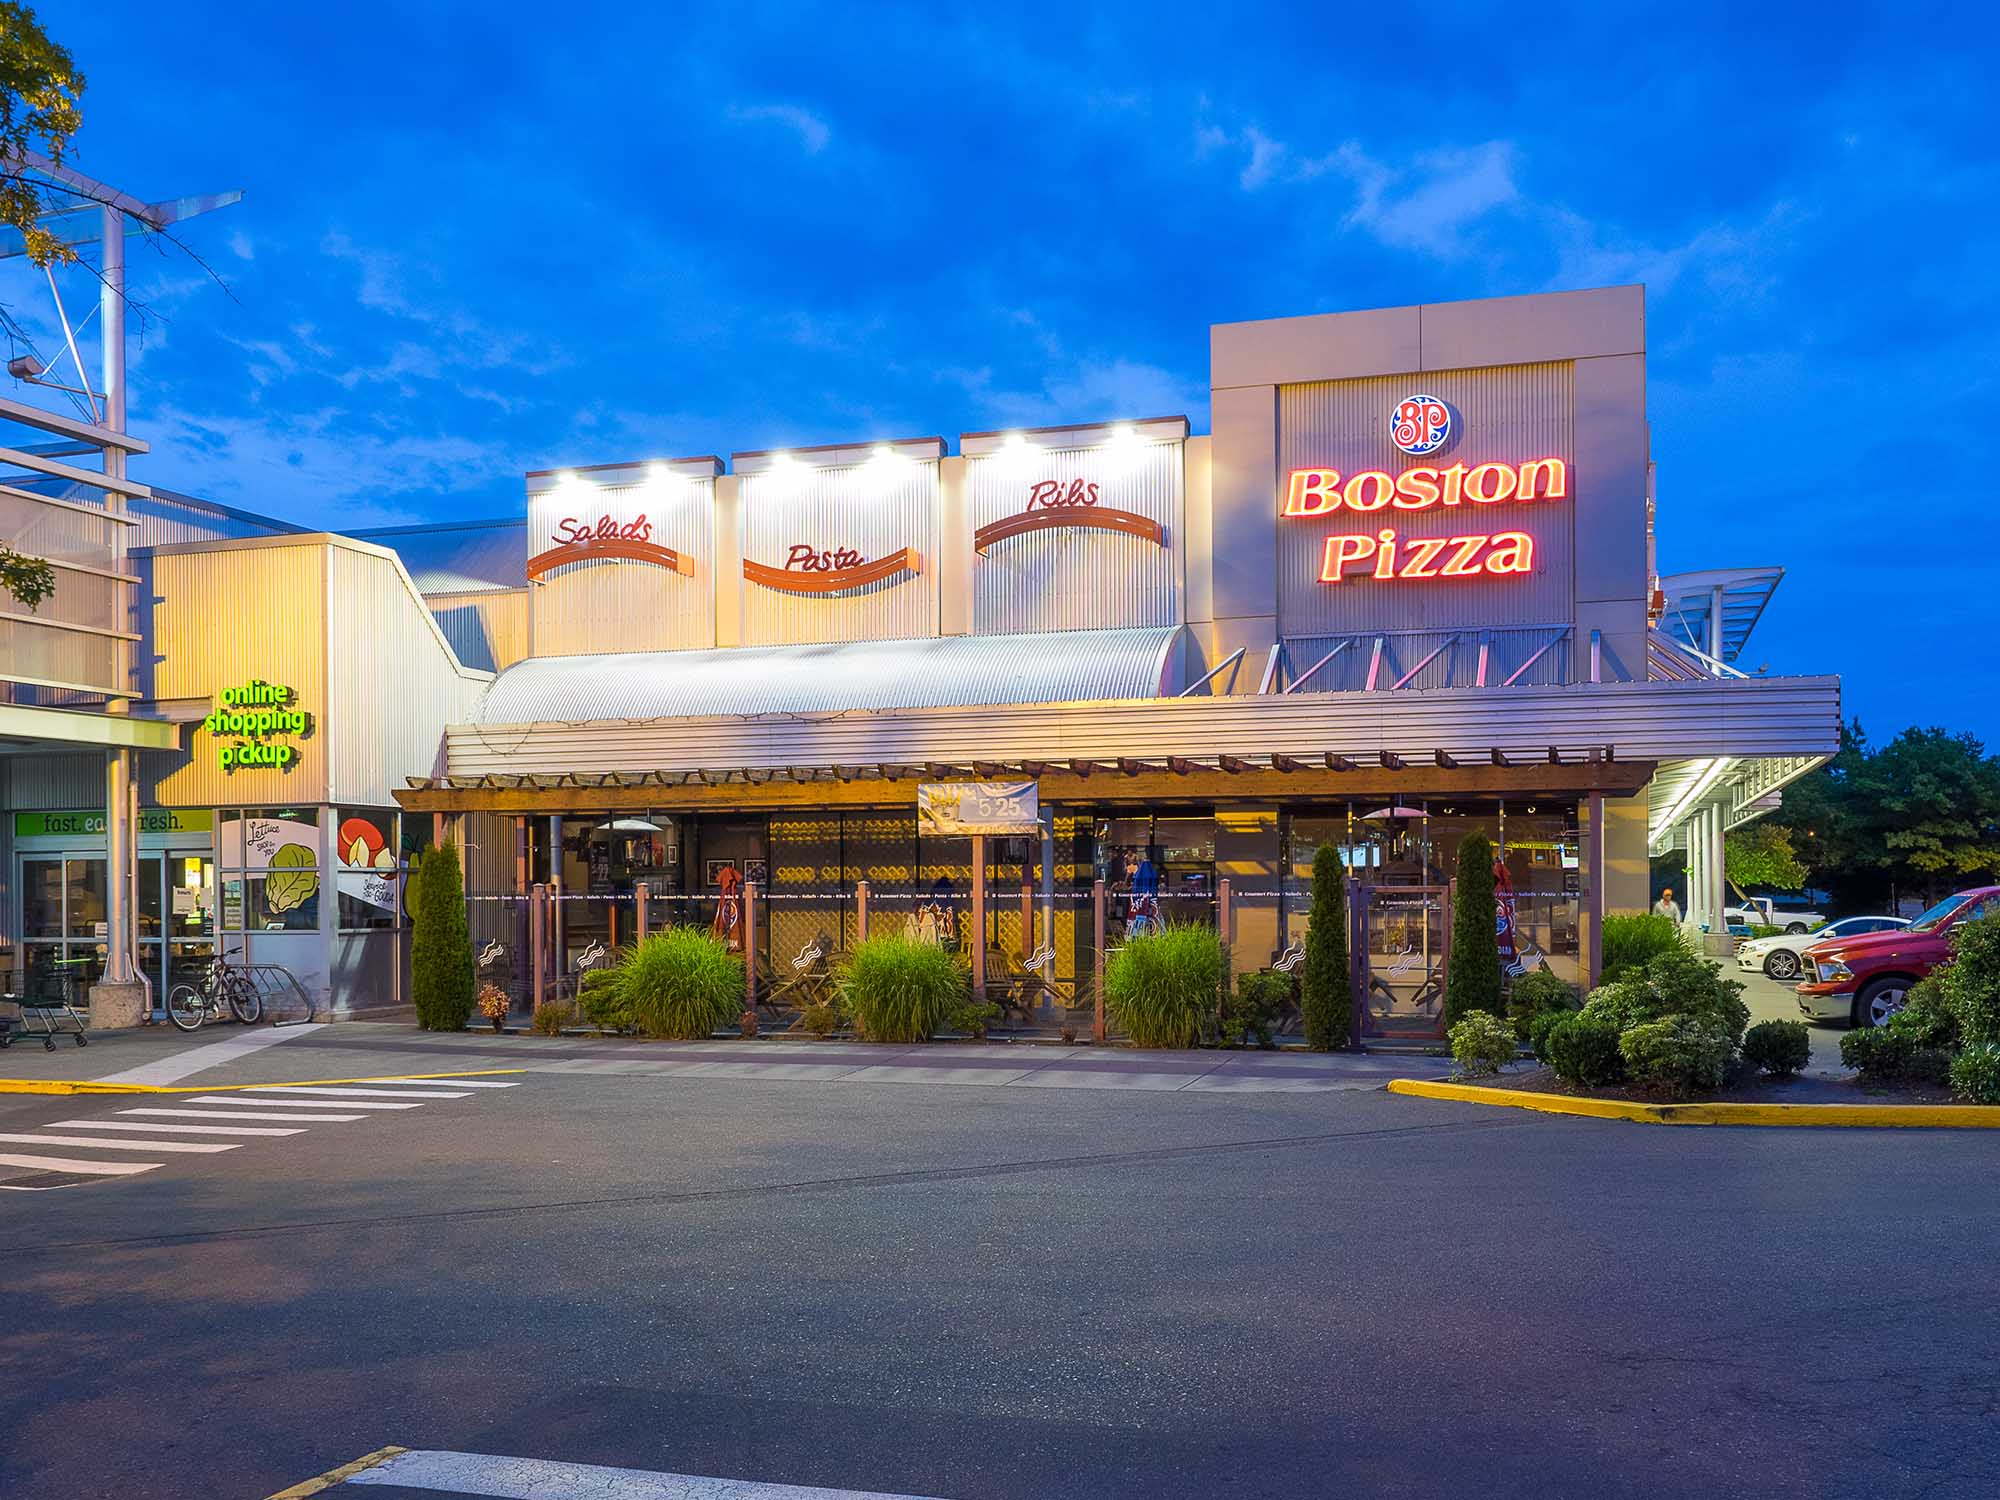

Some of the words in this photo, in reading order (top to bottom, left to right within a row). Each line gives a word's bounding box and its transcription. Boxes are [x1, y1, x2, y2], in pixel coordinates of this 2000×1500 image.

[1026, 478, 1099, 512] Ribs
[1281, 457, 1567, 518] Boston
[551, 513, 652, 544] Salads
[784, 544, 864, 571] Pasta
[1317, 529, 1535, 583] Pizza
[220, 679, 288, 705] online
[205, 704, 305, 737] shopping
[218, 740, 291, 771] pickup
